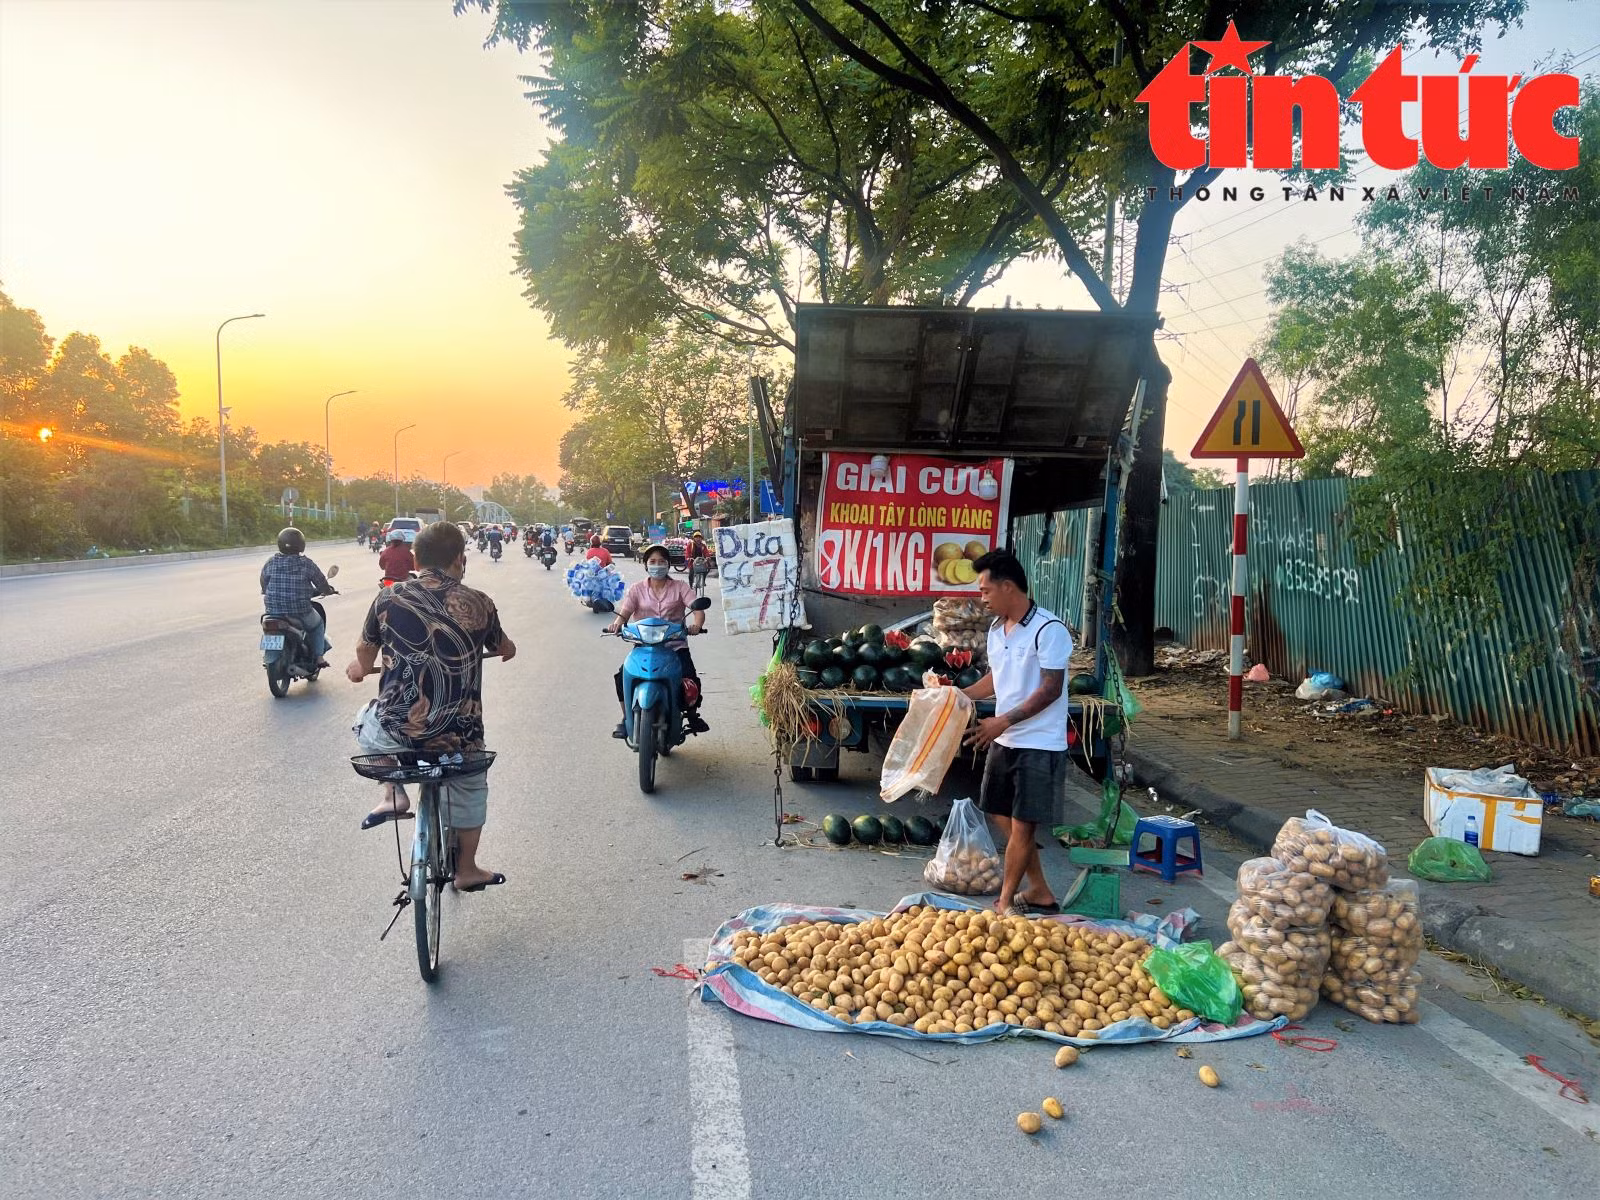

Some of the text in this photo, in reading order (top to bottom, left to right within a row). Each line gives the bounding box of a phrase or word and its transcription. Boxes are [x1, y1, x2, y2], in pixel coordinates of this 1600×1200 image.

[830, 502, 993, 530] KHOAI TÂY LÒNG VÀNG
